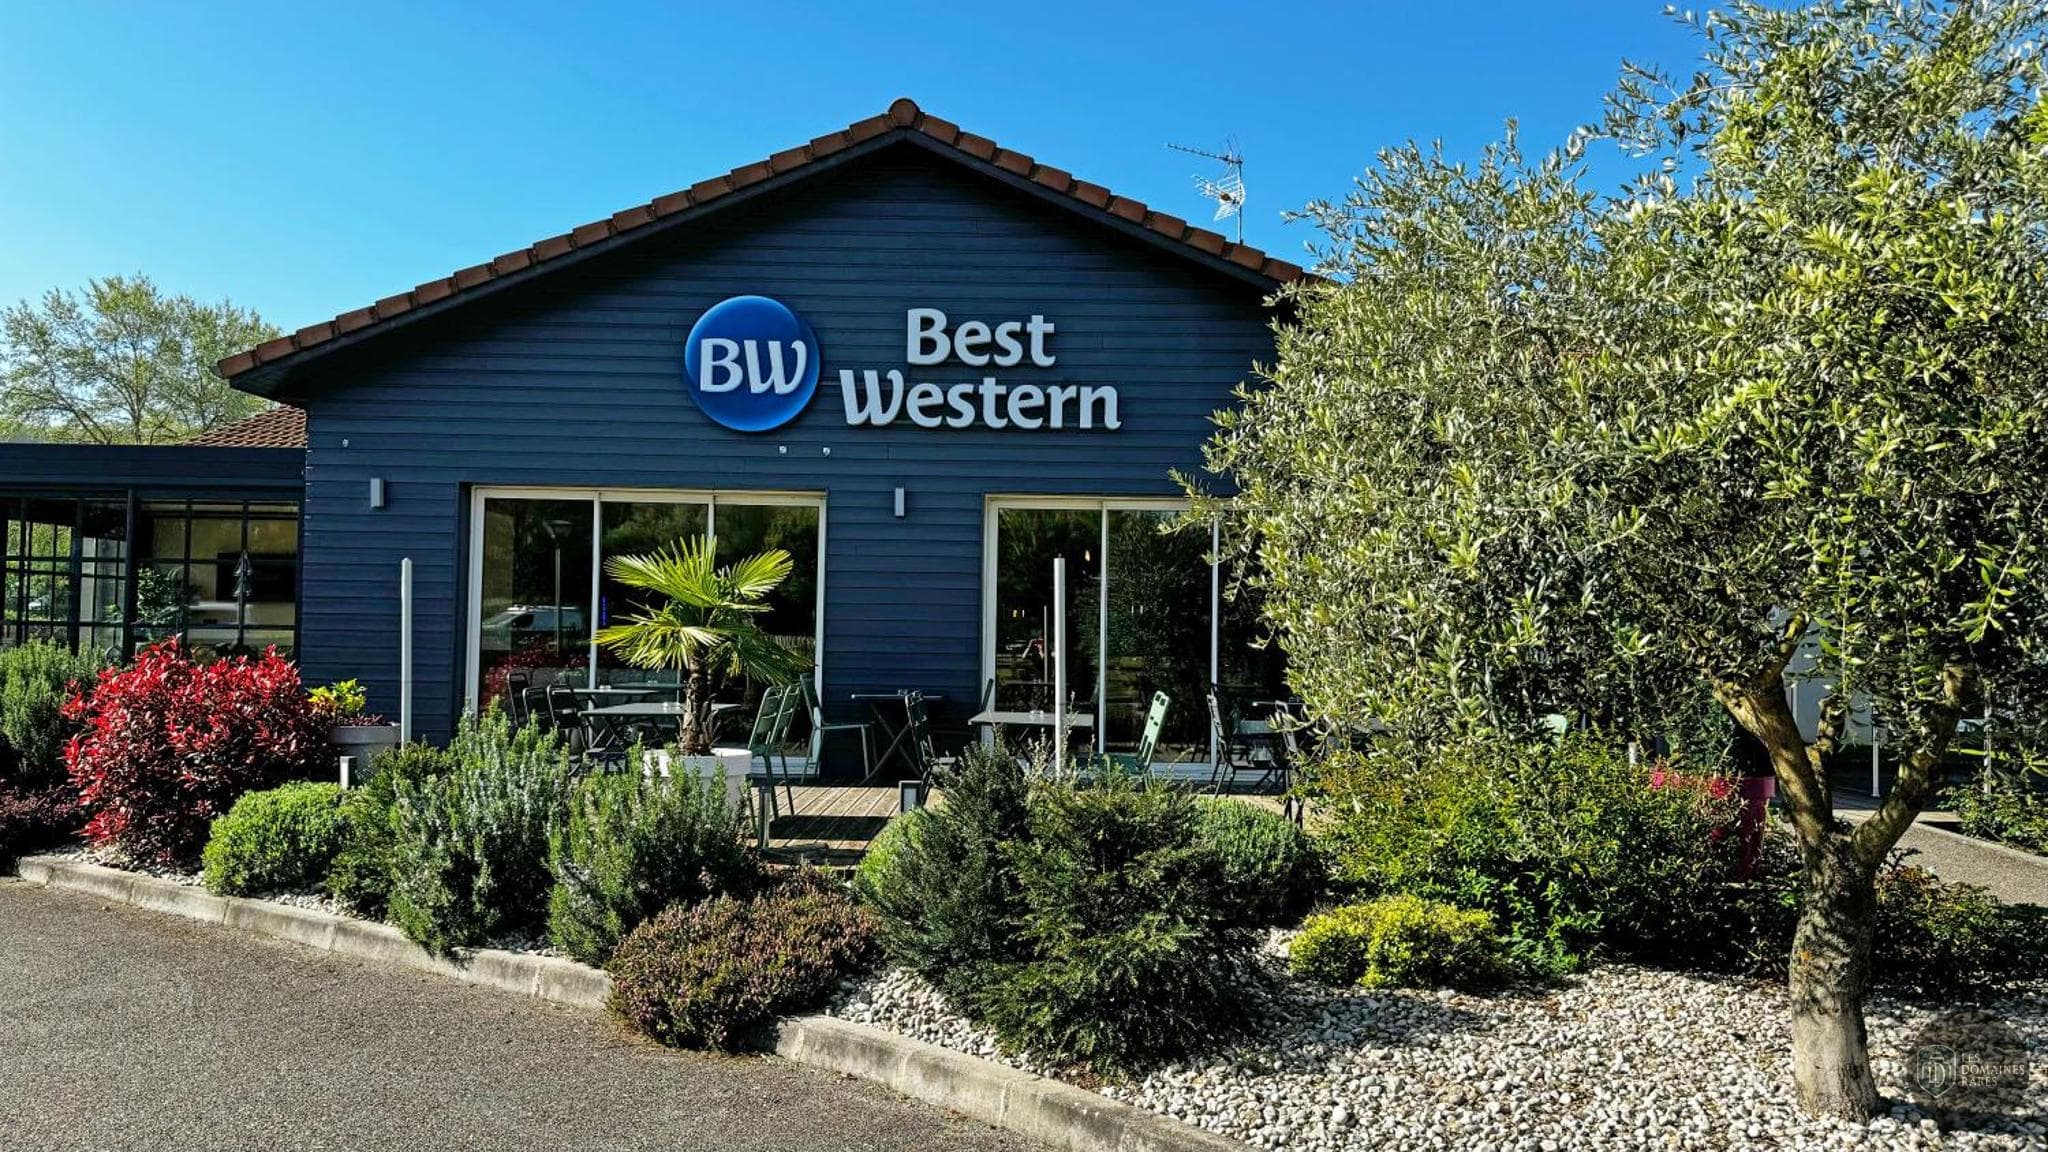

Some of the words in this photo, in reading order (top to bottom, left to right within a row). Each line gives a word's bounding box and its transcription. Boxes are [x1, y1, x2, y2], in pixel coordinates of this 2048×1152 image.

[701, 337, 807, 394] BW
[907, 308, 1056, 367] Best
[839, 368, 1122, 430] Western
